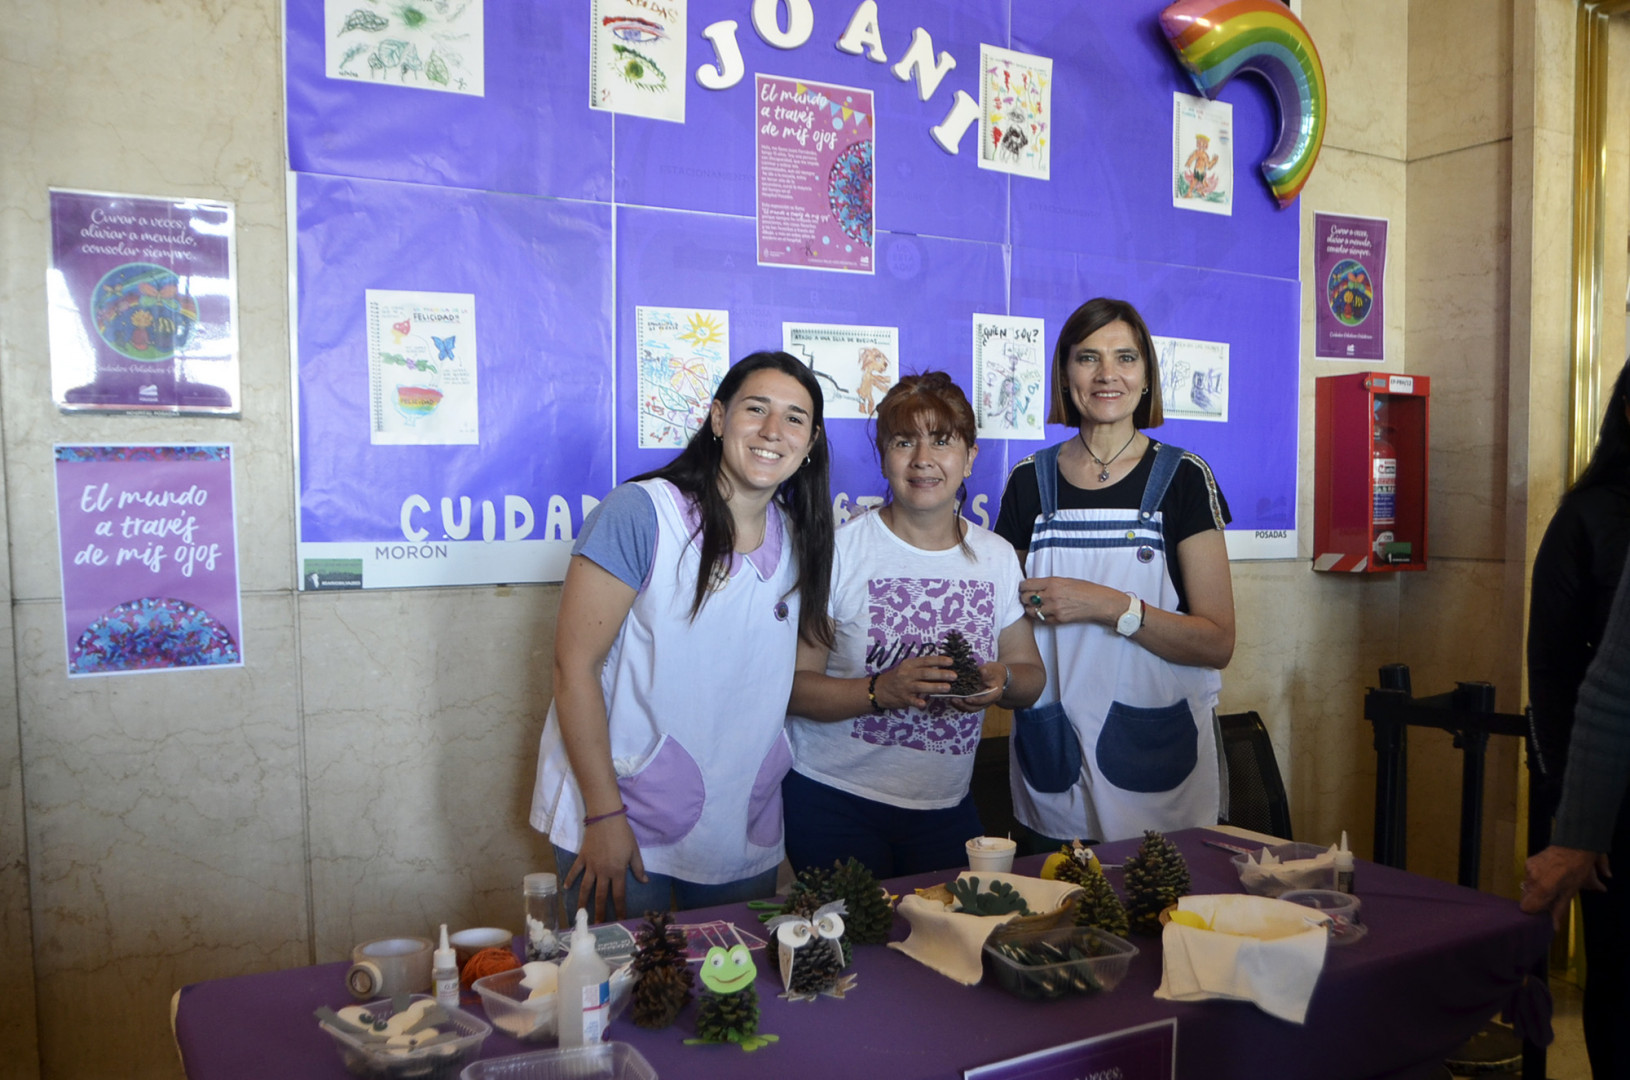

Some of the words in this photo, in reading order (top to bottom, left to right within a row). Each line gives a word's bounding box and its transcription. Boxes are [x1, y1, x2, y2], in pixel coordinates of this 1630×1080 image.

[696, 0, 979, 154] JOANI
[761, 83, 779, 102] El
[780, 90, 829, 106] mundo
[761, 106, 770, 117] a
[774, 105, 815, 129] través
[761, 121, 779, 136] de
[782, 125, 809, 146] mis
[812, 129, 838, 152] ojos
[91, 208, 136, 226] Curar
[138, 217, 149, 227] a
[150, 217, 187, 230] veces,
[1330, 224, 1349, 236] Curar
[80, 224, 128, 239] aliviar
[128, 231, 139, 242] a
[141, 230, 198, 247] menudo,
[81, 242, 141, 256] consolar
[143, 245, 198, 265] siempre.
[80, 483, 113, 513] El
[117, 484, 208, 509] mundo
[95, 520, 113, 537] a
[120, 509, 199, 544] través
[1255, 530, 1287, 538] POSADAS
[74, 543, 109, 566] de
[116, 542, 167, 573] mis
[174, 542, 222, 578] ojos
[376, 542, 448, 560] MORÓN
